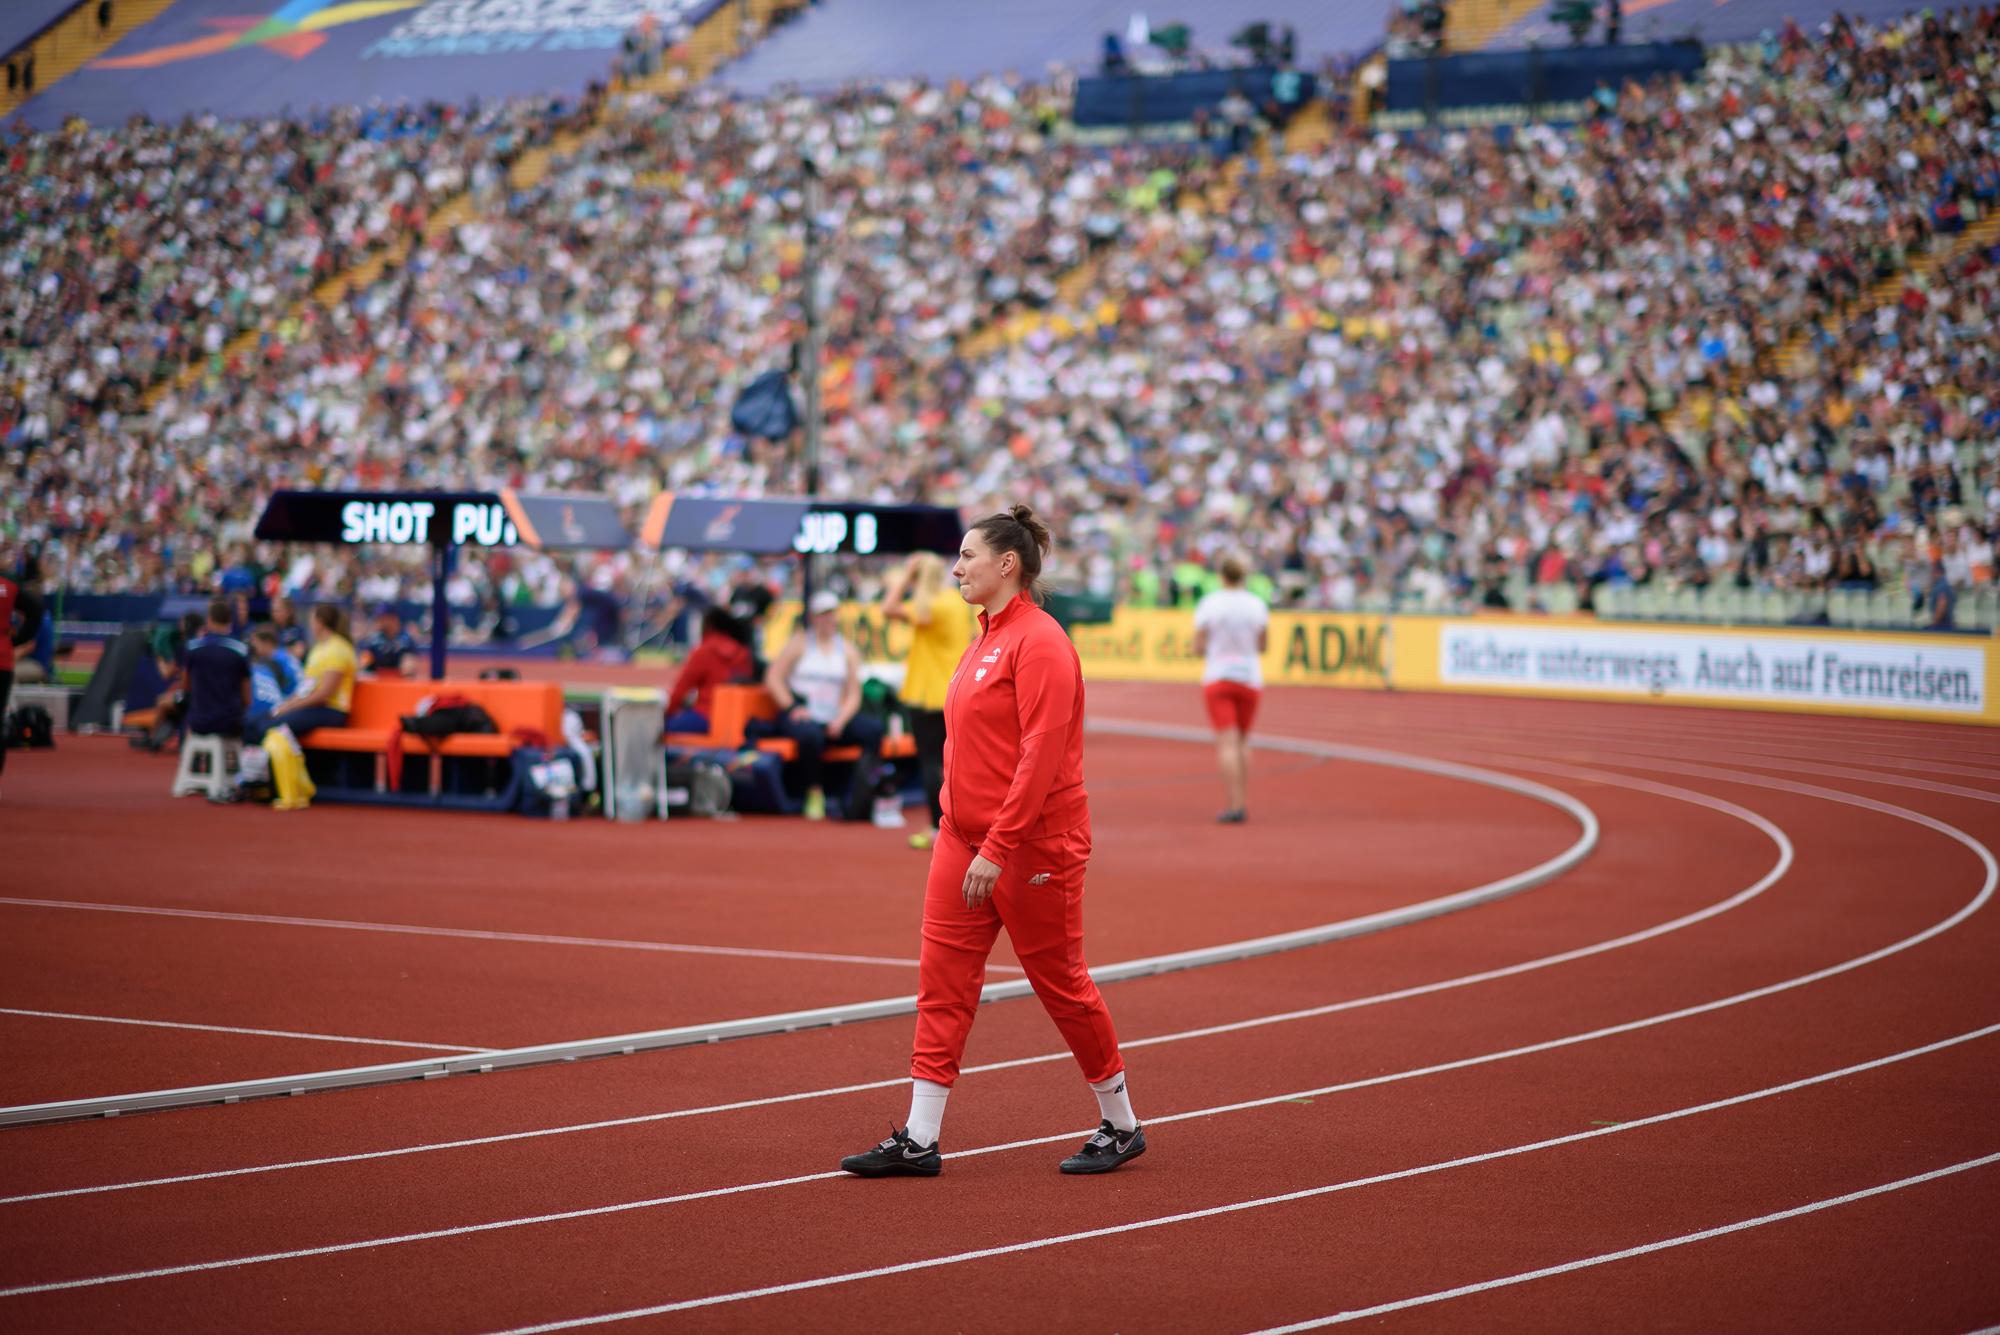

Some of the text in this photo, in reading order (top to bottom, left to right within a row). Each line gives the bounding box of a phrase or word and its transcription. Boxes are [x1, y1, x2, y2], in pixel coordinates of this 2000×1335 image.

[341, 501, 435, 544] SHOT
[1451, 634, 1979, 704] Sicher unterwegs. Auch auf Fernreisen.
